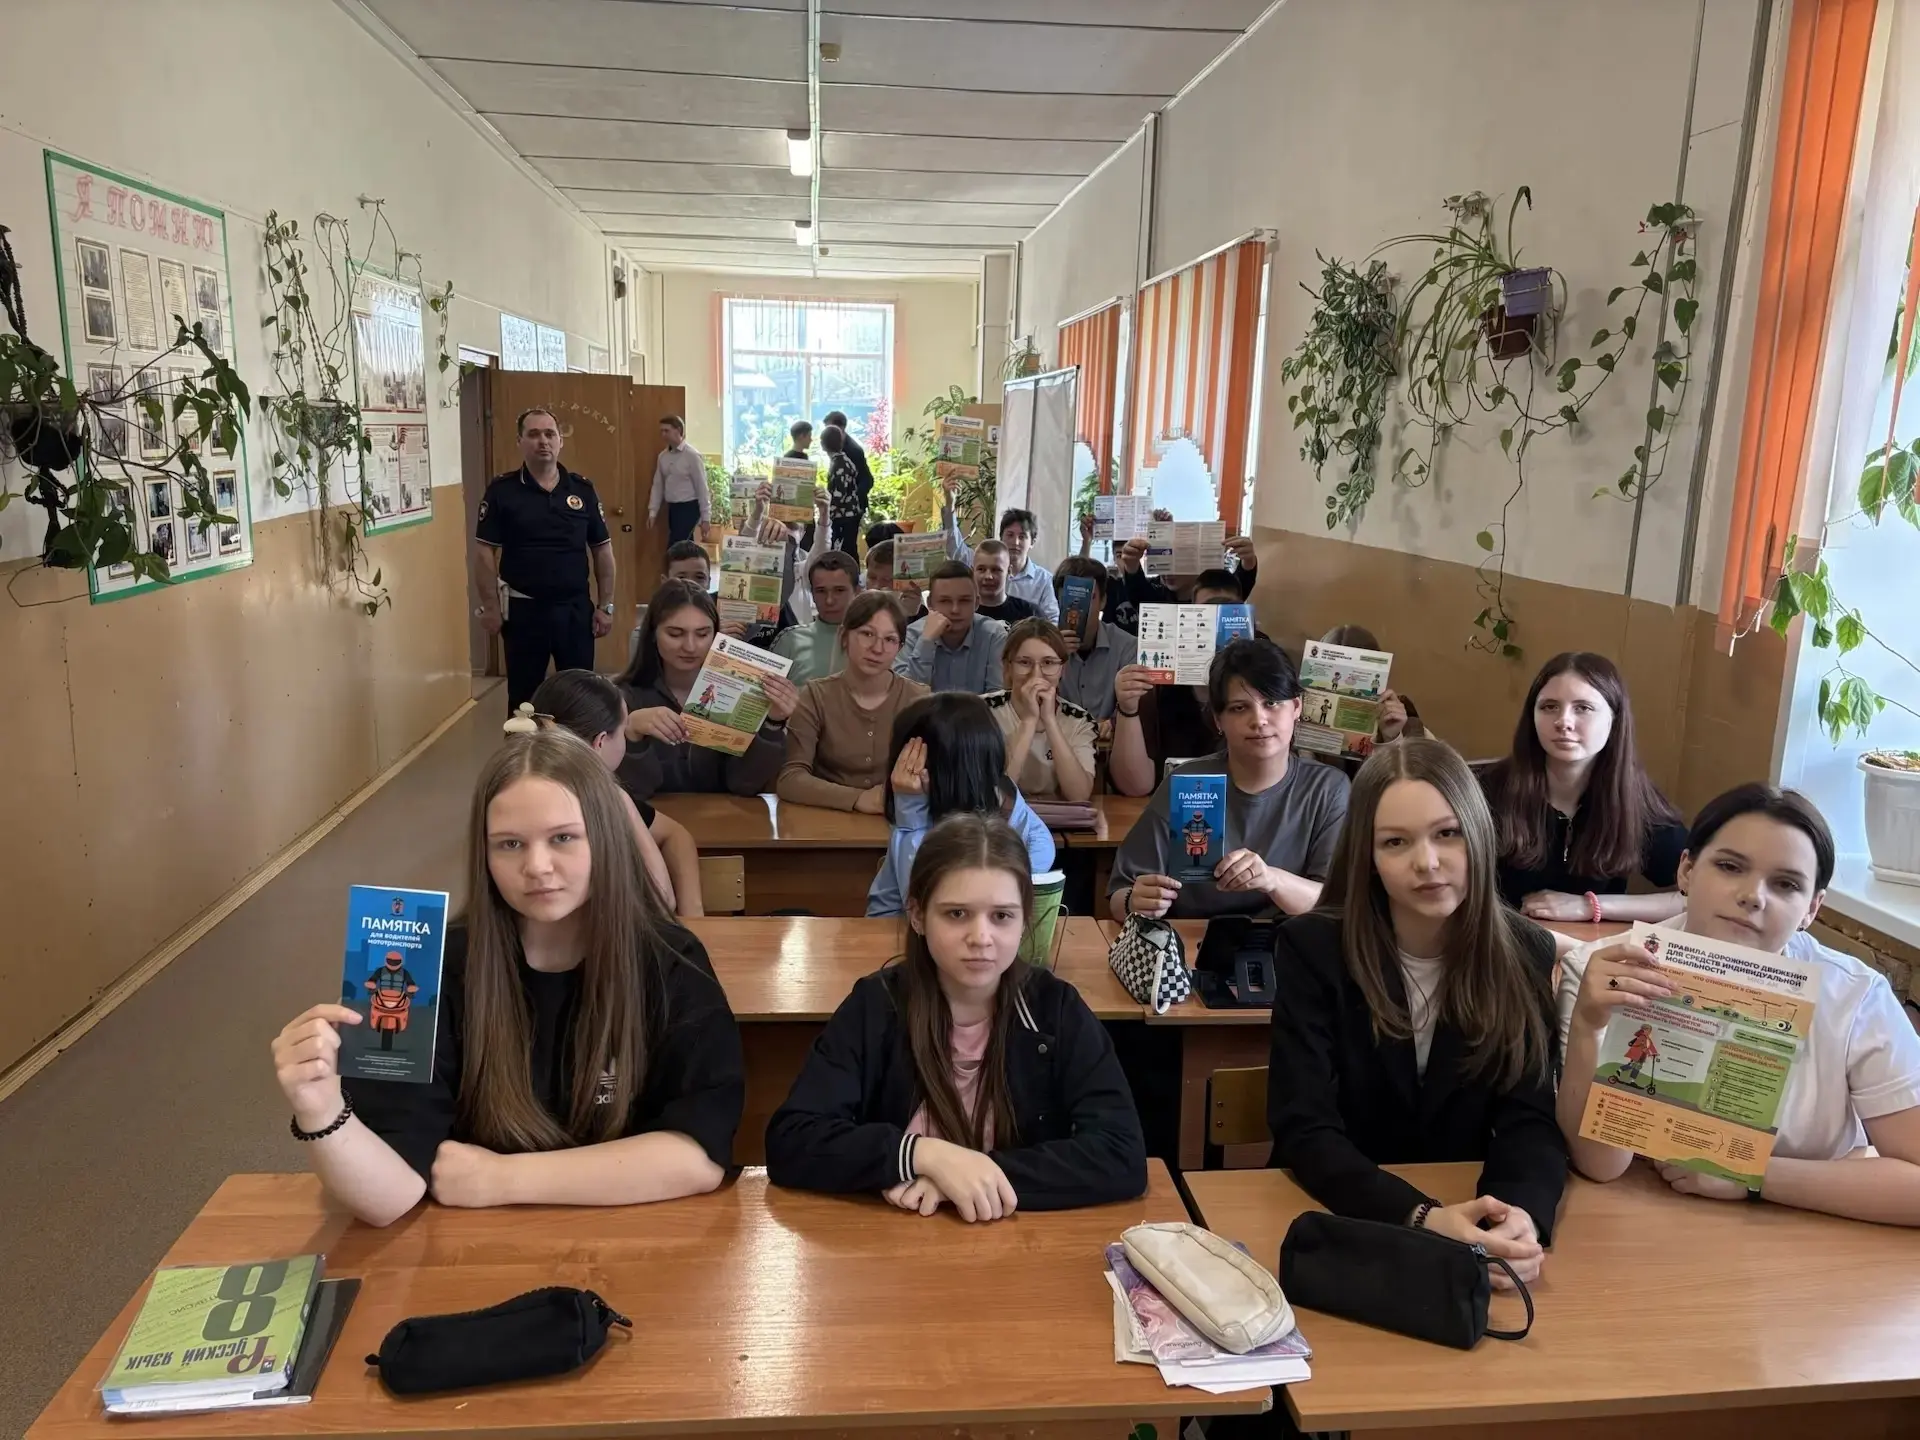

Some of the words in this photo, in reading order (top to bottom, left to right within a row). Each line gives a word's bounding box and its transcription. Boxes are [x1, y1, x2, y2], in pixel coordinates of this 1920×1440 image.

[70, 174, 93, 223] Я
[107, 186, 214, 251] ПОМНЮ
[1178, 792, 1219, 800] ПАМЯТКА
[361, 916, 431, 935] ПАМЯТКА
[367, 939, 422, 950] мототранспорта
[384, 933, 421, 942] водителей
[1665, 956, 1726, 976] МОБИЛЬНОСТИ
[1666, 949, 1684, 958] ДЛЯ
[1685, 953, 1721, 967] СРЕДСТВ
[1721, 962, 1802, 987] ИНДИВИДУАЛЬНОЙ
[1667, 942, 1706, 957] ПРАВИЛА
[1708, 951, 1760, 970] ДОРОЖНОГО
[1760, 964, 1808, 982] ДВИЖЕНИЯ
[1705, 979, 1740, 991] ОТНОСИТСЯ
[202, 1259, 290, 1341] 8
